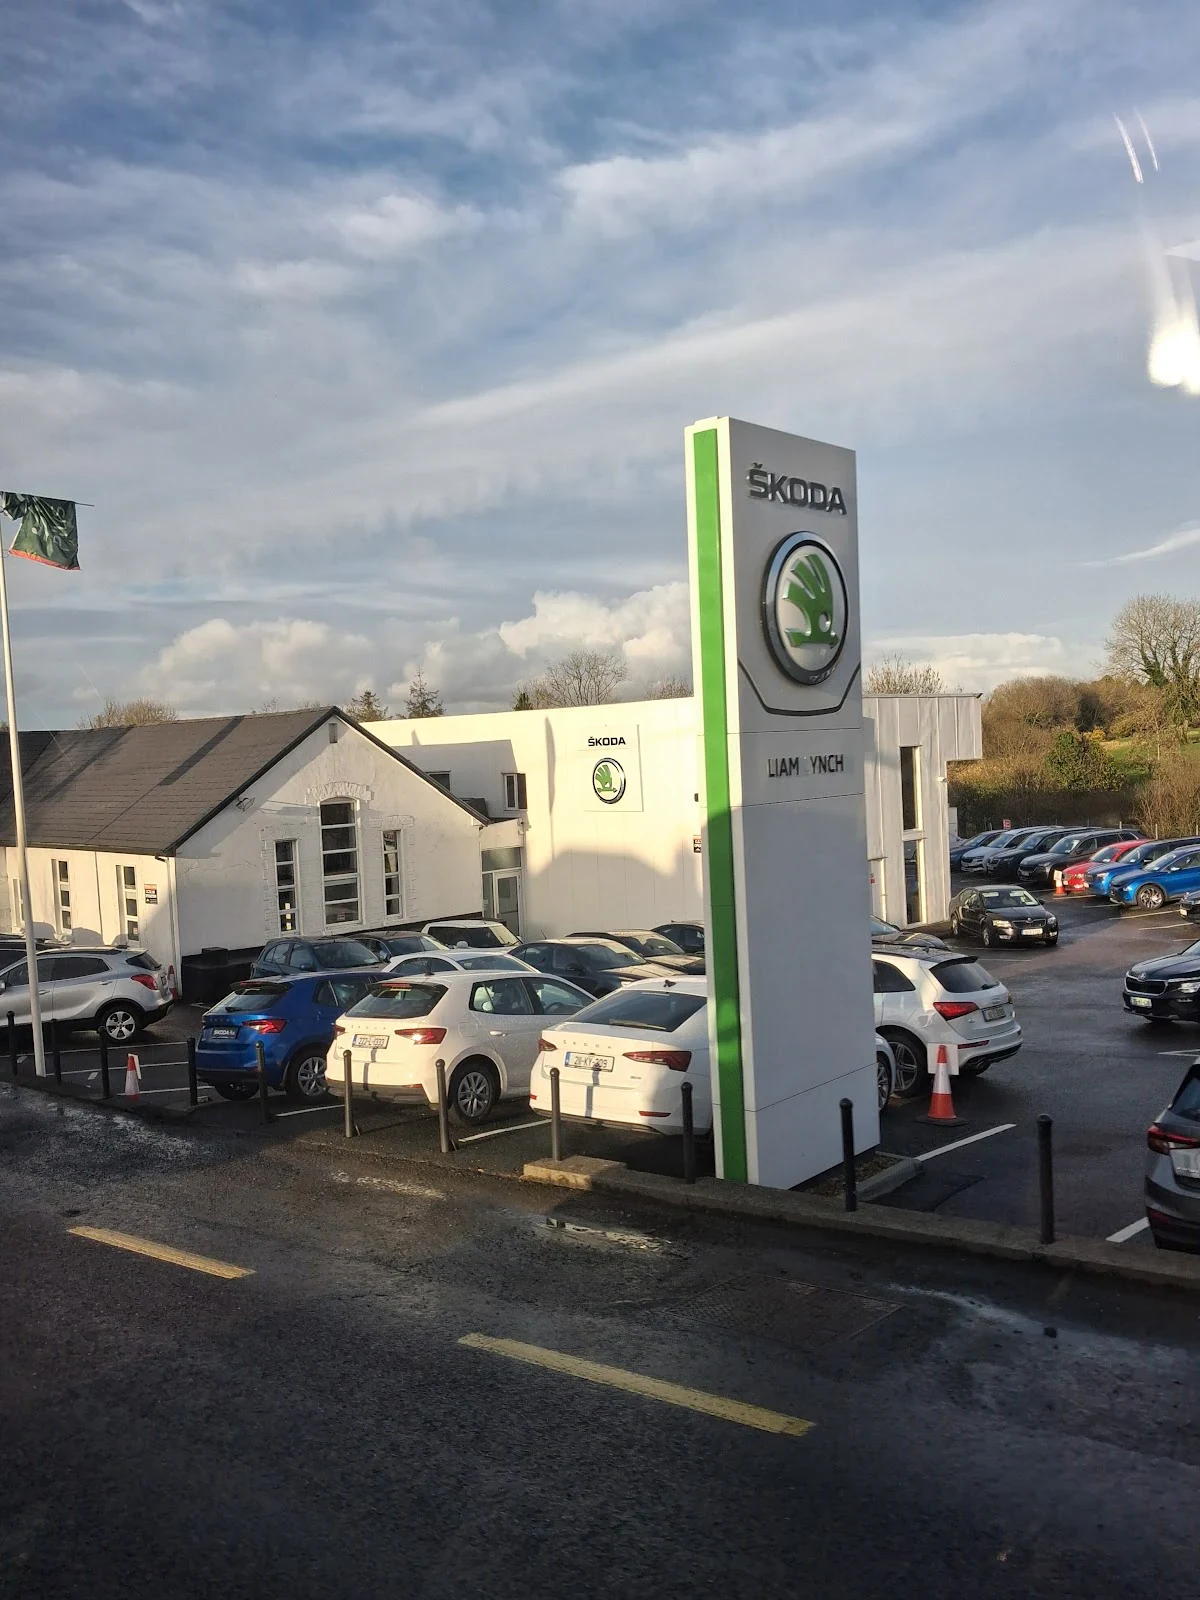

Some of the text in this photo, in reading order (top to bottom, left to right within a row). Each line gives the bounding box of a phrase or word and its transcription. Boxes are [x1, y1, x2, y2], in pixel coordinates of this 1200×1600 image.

[746, 462, 847, 515] ŠKODA
[588, 736, 626, 746] ŠKODA
[767, 754, 844, 777] LIAM YNCH
